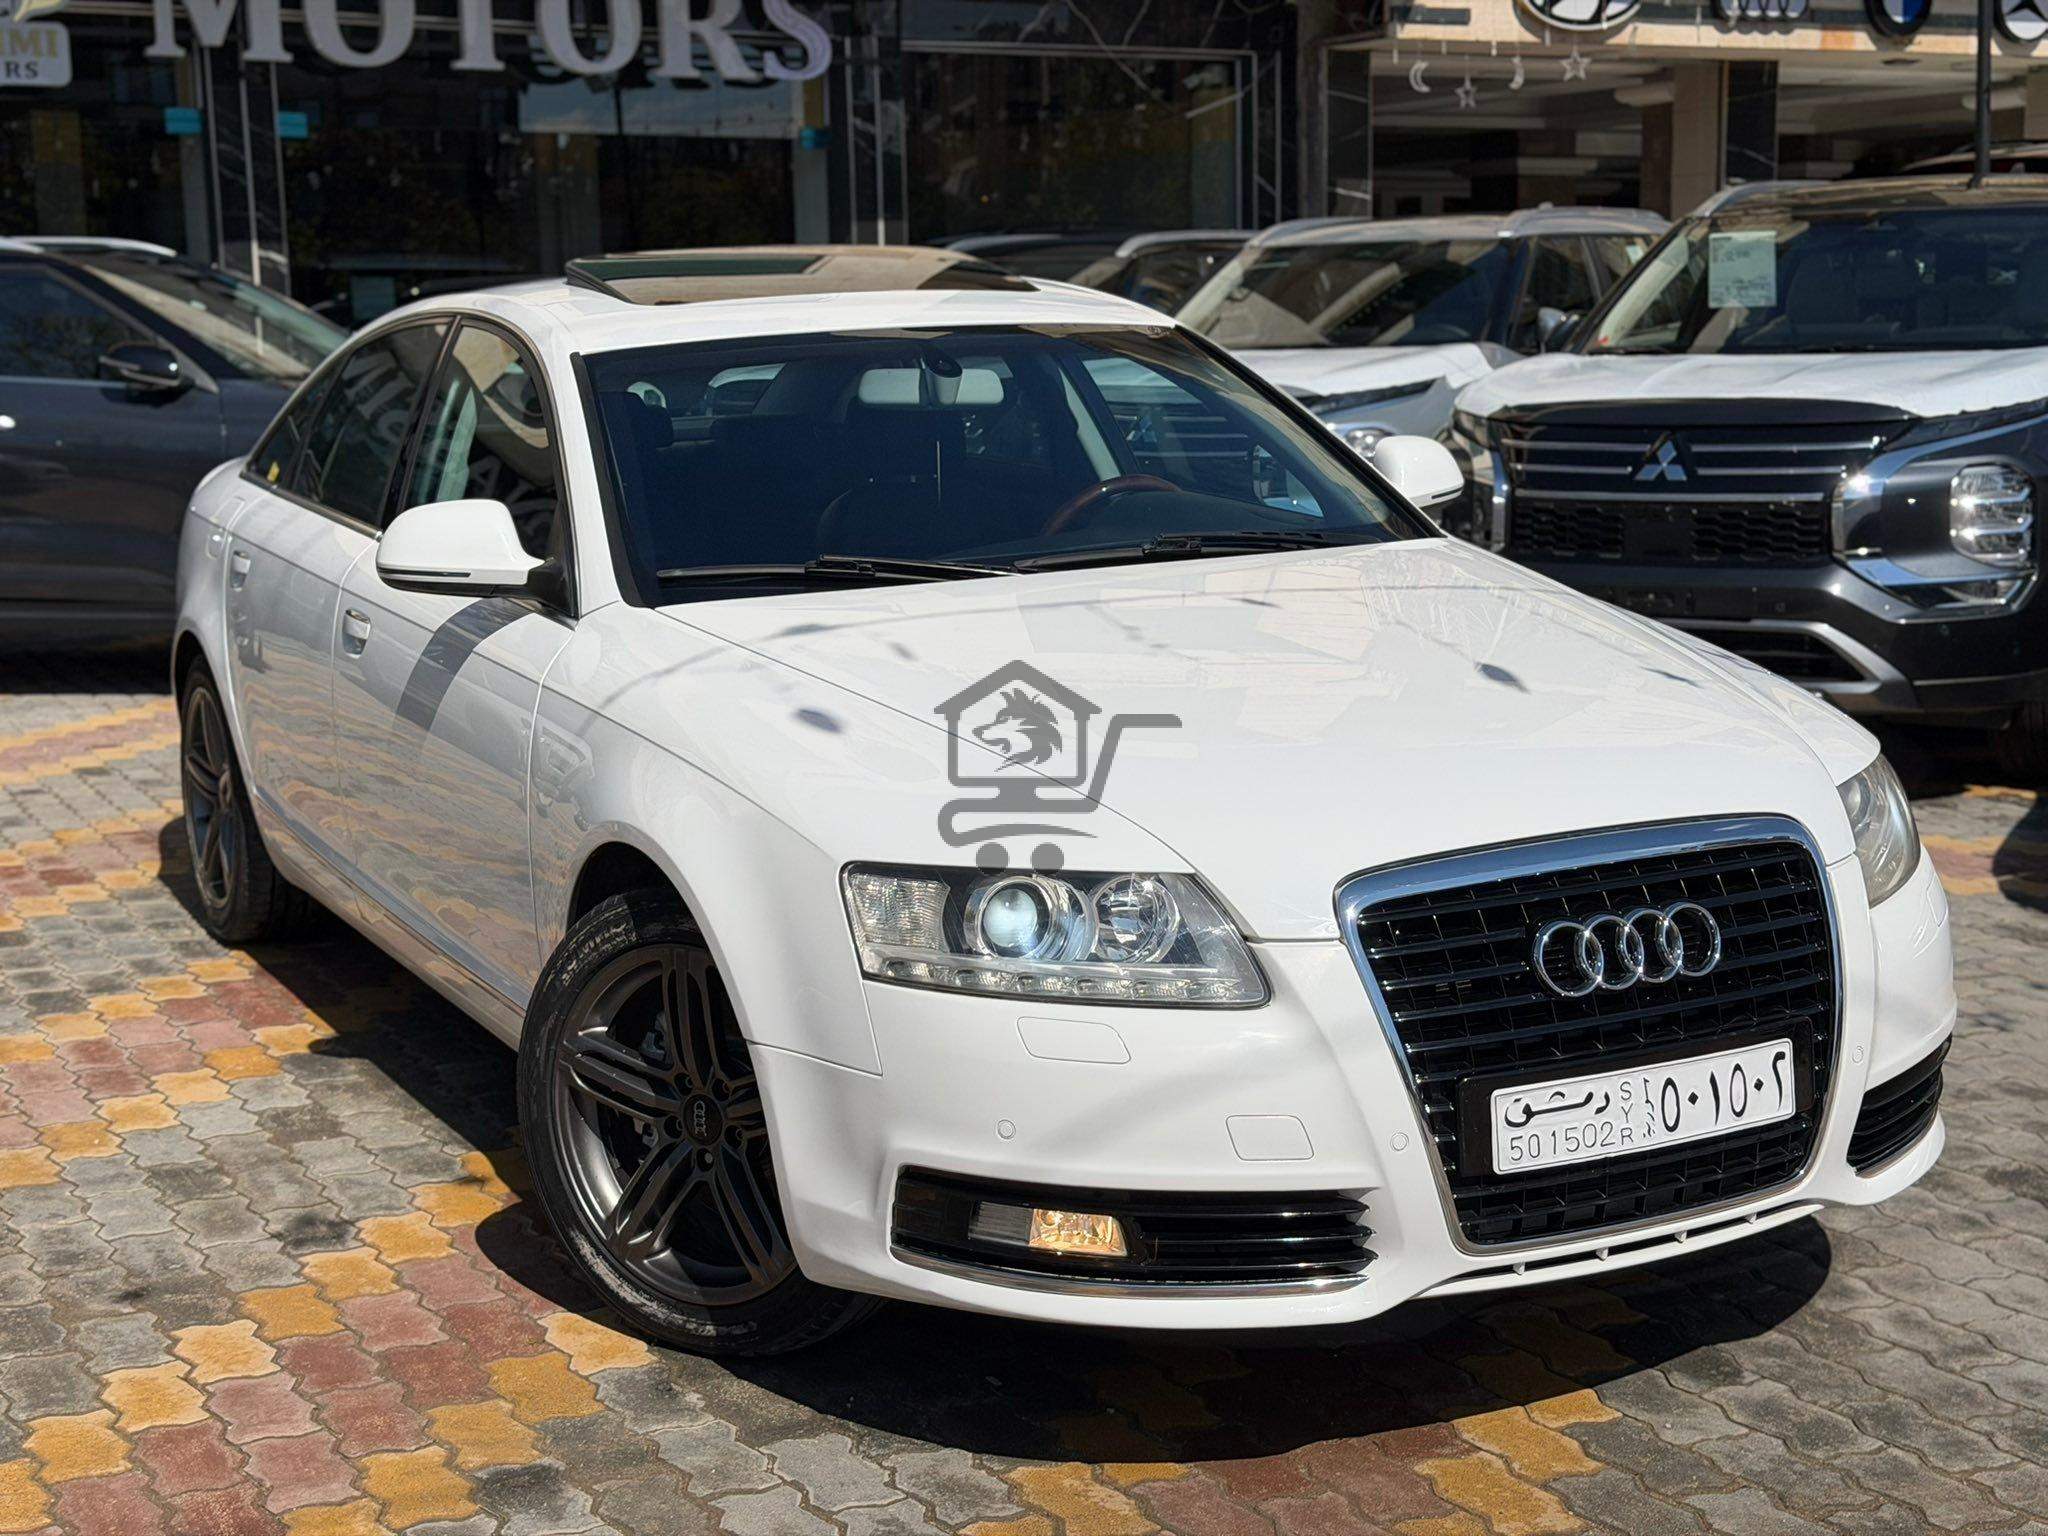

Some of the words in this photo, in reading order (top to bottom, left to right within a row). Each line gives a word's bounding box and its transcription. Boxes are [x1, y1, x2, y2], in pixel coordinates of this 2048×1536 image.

[144, 0, 832, 81] MOTORS
[1504, 1091, 1611, 1128] دمشق
[1660, 1050, 1787, 1134] ٥٠١٥٠٢
[1510, 1121, 1616, 1162] 501502
